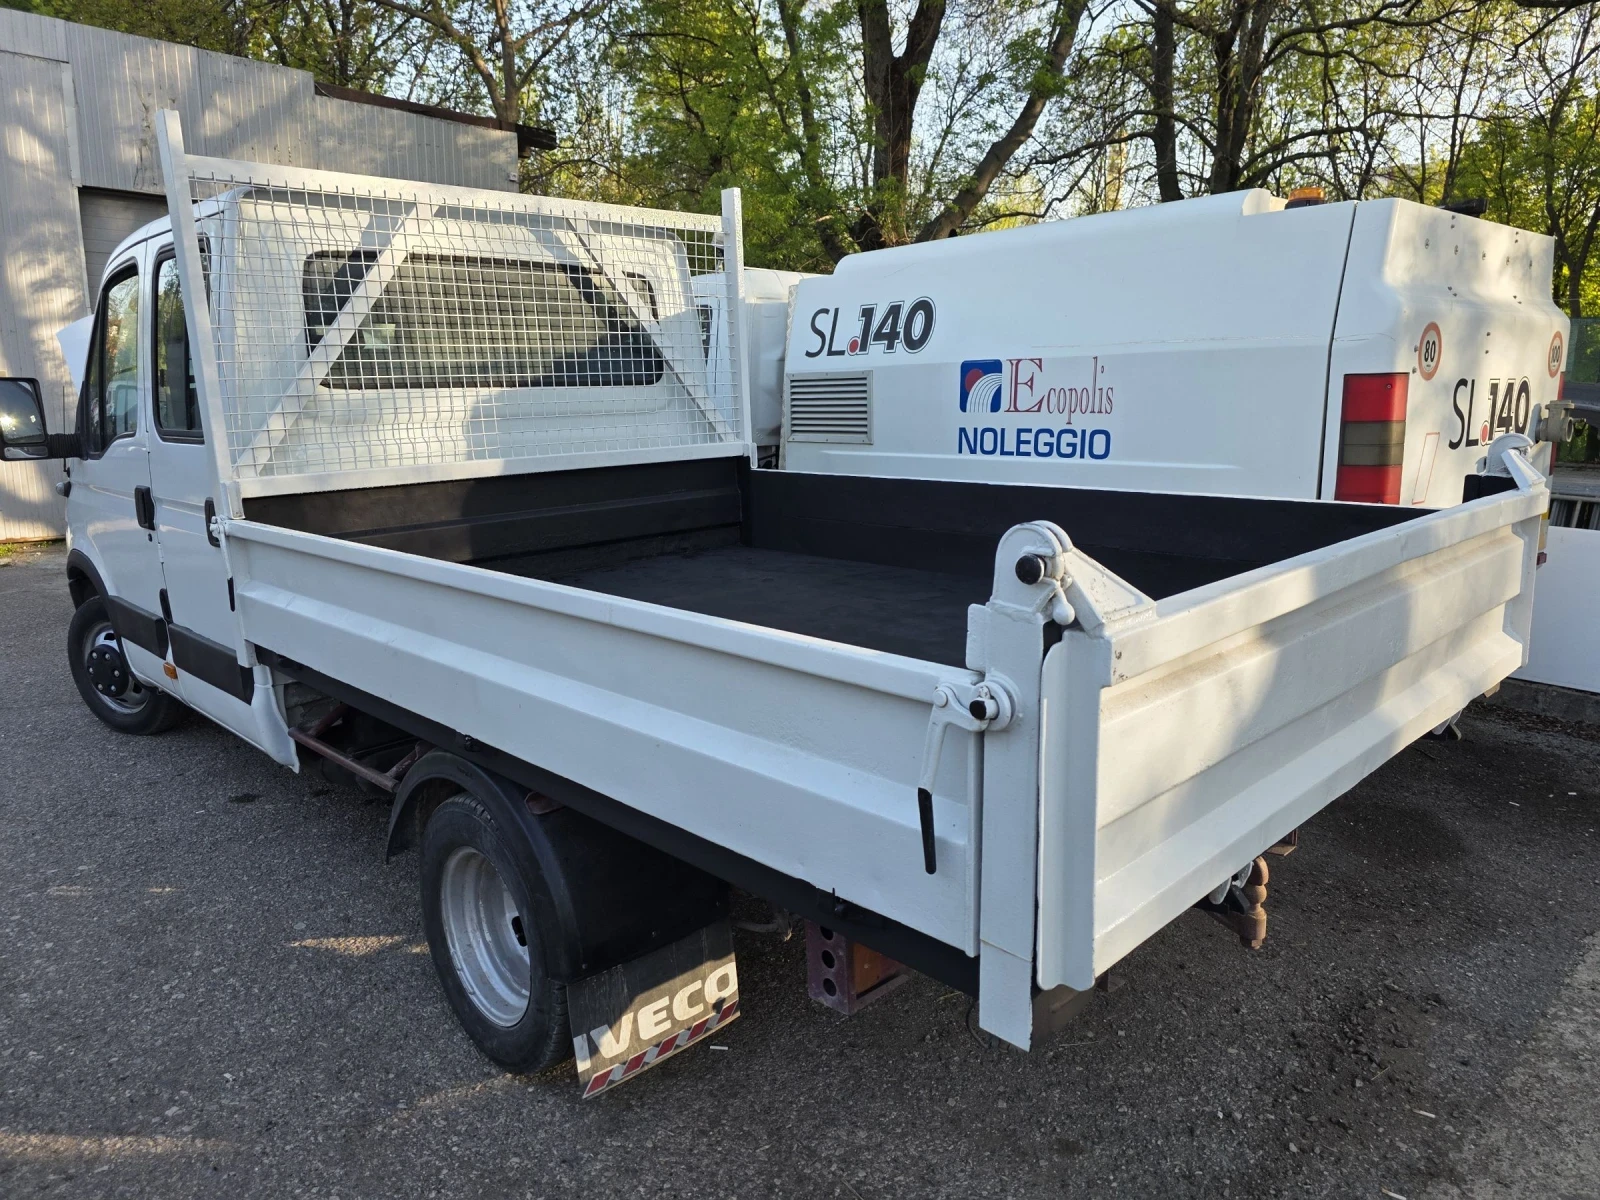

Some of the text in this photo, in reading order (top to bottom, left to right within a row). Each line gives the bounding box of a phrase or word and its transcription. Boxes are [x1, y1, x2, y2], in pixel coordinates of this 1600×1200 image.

[805, 296, 936, 358] SL.140
[1424, 340, 1436, 363] 80
[1004, 356, 1114, 425] Ecopolis
[957, 427, 1111, 460] NOLEGGIO
[573, 962, 739, 1073] IVECO
